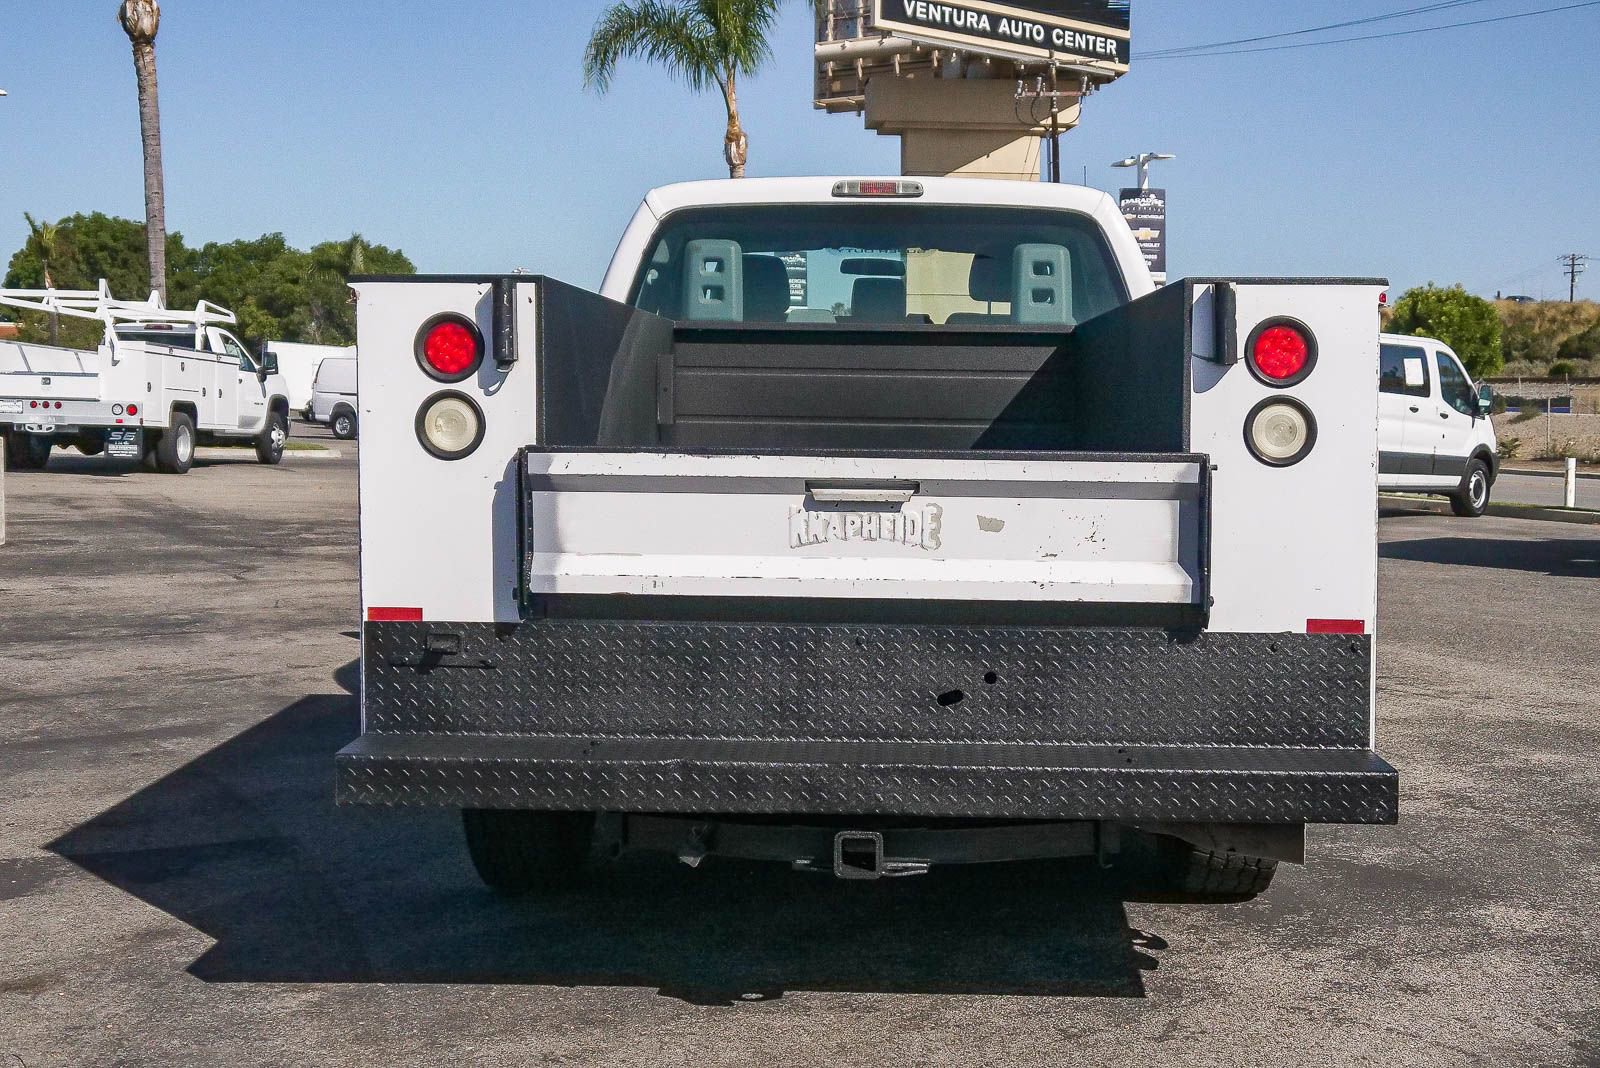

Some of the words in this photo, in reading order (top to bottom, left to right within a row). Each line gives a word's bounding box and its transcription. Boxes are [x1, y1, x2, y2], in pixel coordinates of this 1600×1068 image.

[904, 0, 990, 30] VENTURA
[998, 18, 1046, 42] AUTO
[1052, 28, 1117, 54] CENTER
